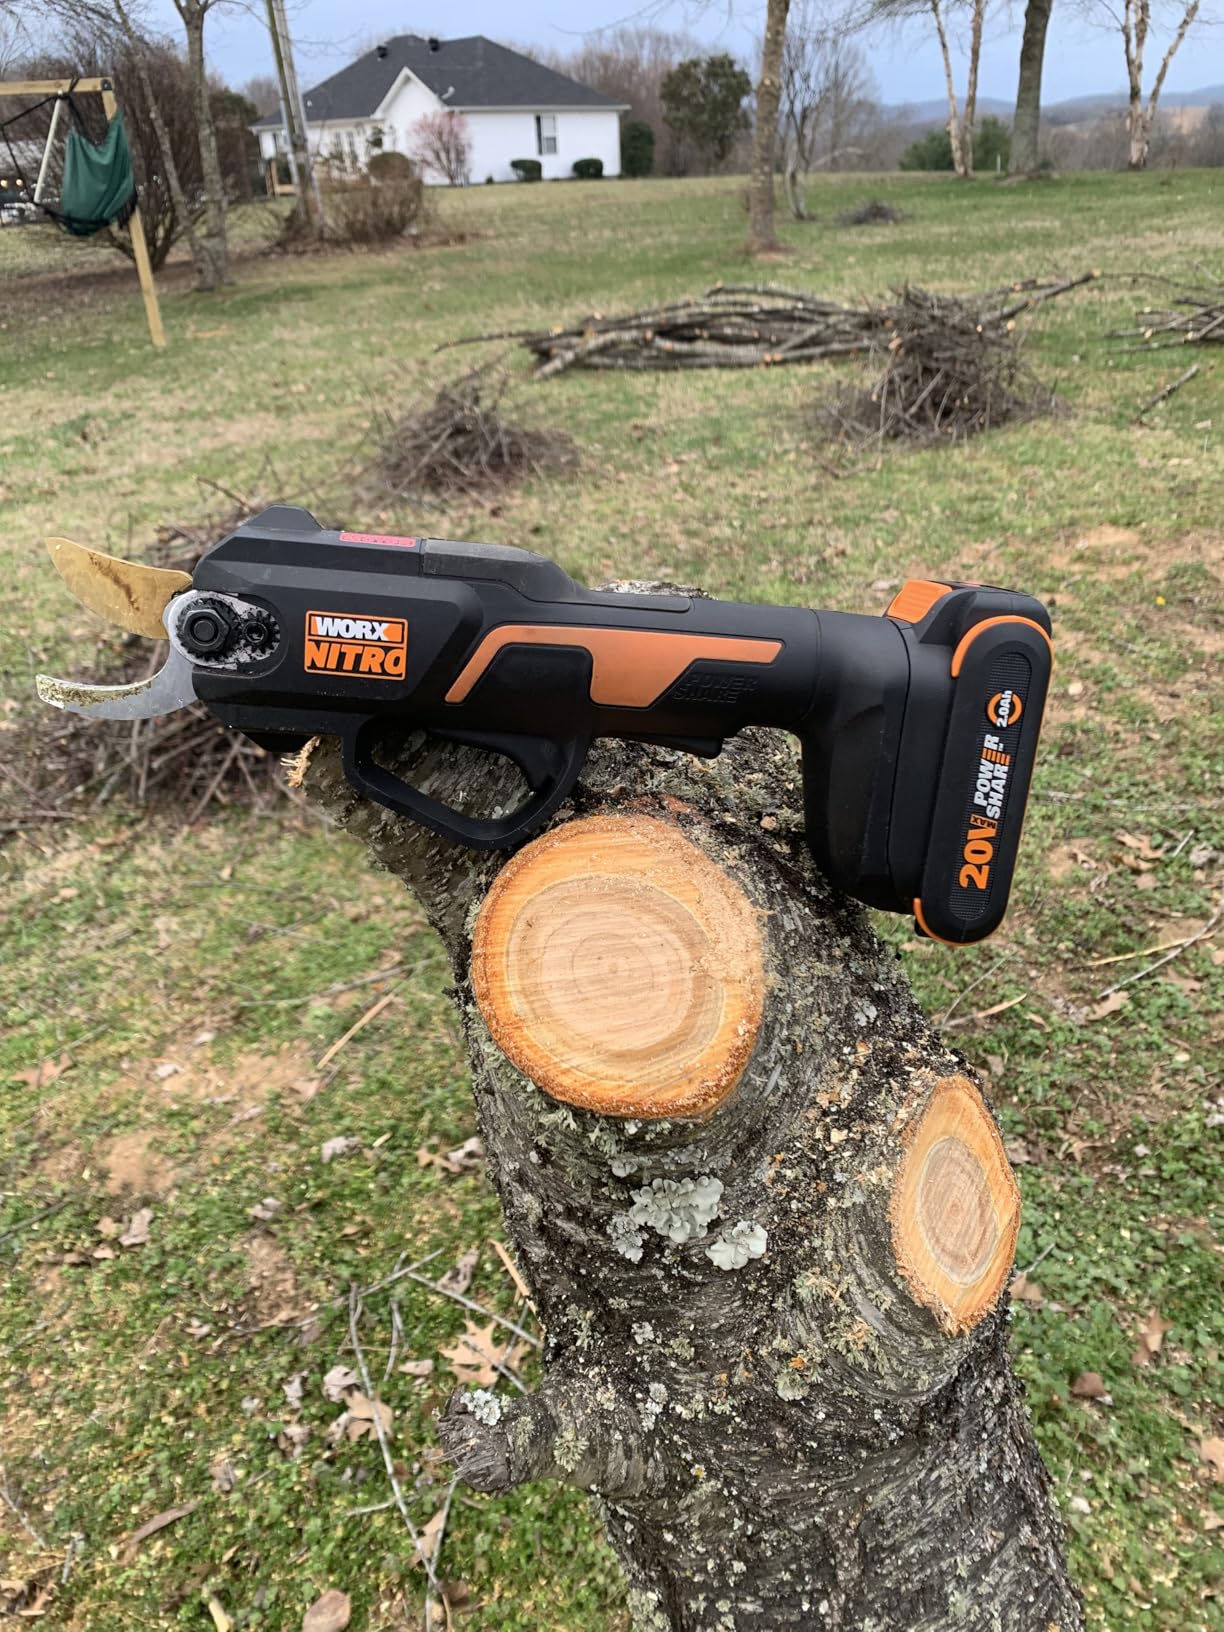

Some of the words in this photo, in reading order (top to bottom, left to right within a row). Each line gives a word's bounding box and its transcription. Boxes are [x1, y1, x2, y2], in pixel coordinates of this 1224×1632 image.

[314, 616, 390, 641] WORX
[305, 641, 403, 675] NITRO
[996, 690, 1013, 728] 2.0Ah
[974, 734, 999, 807] POWER
[986, 754, 1010, 820] SHARE
[959, 828, 996, 889] 20V
